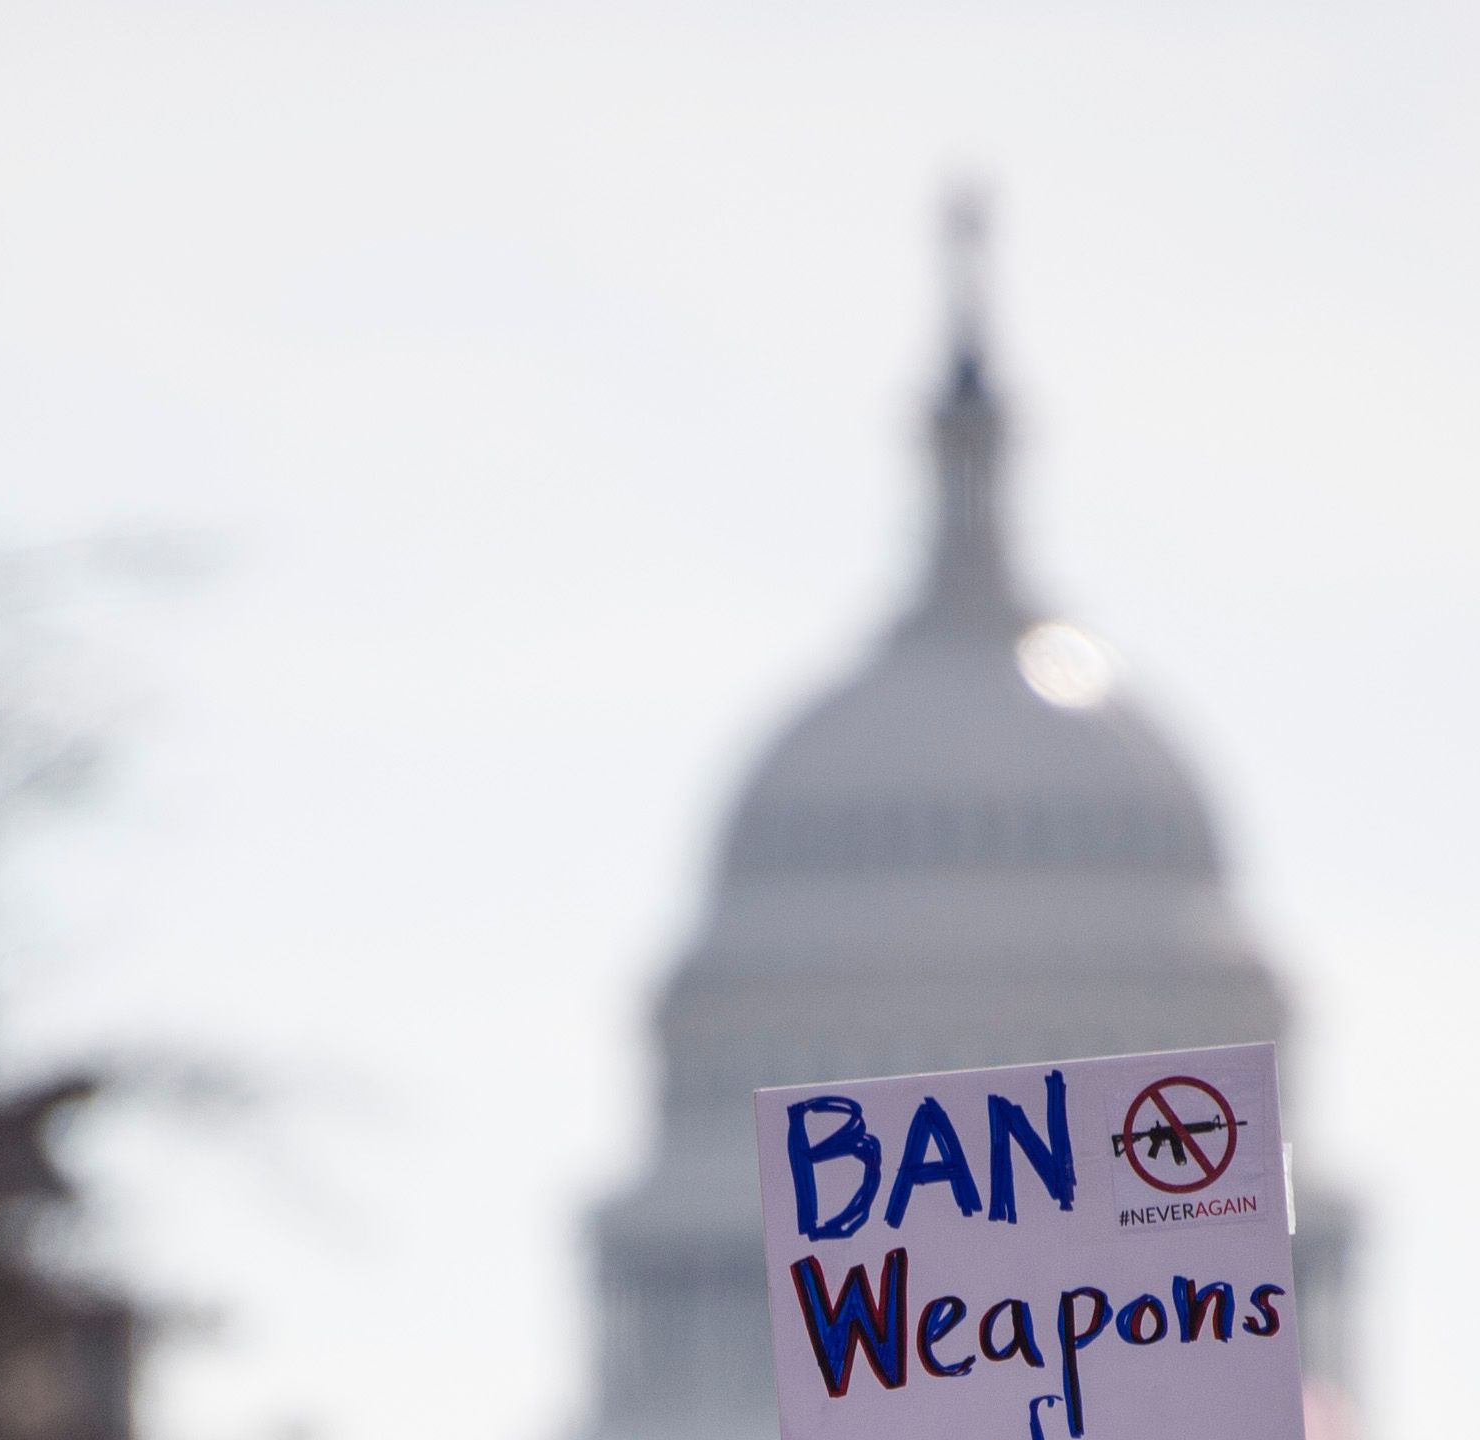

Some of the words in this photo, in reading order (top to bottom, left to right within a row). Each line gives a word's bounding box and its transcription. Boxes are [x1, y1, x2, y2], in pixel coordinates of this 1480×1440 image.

[787, 1070, 1075, 1241] BAN
[1119, 1195, 1258, 1227] #NEVERAGAIN
[790, 1248, 1285, 1438] Weapons
